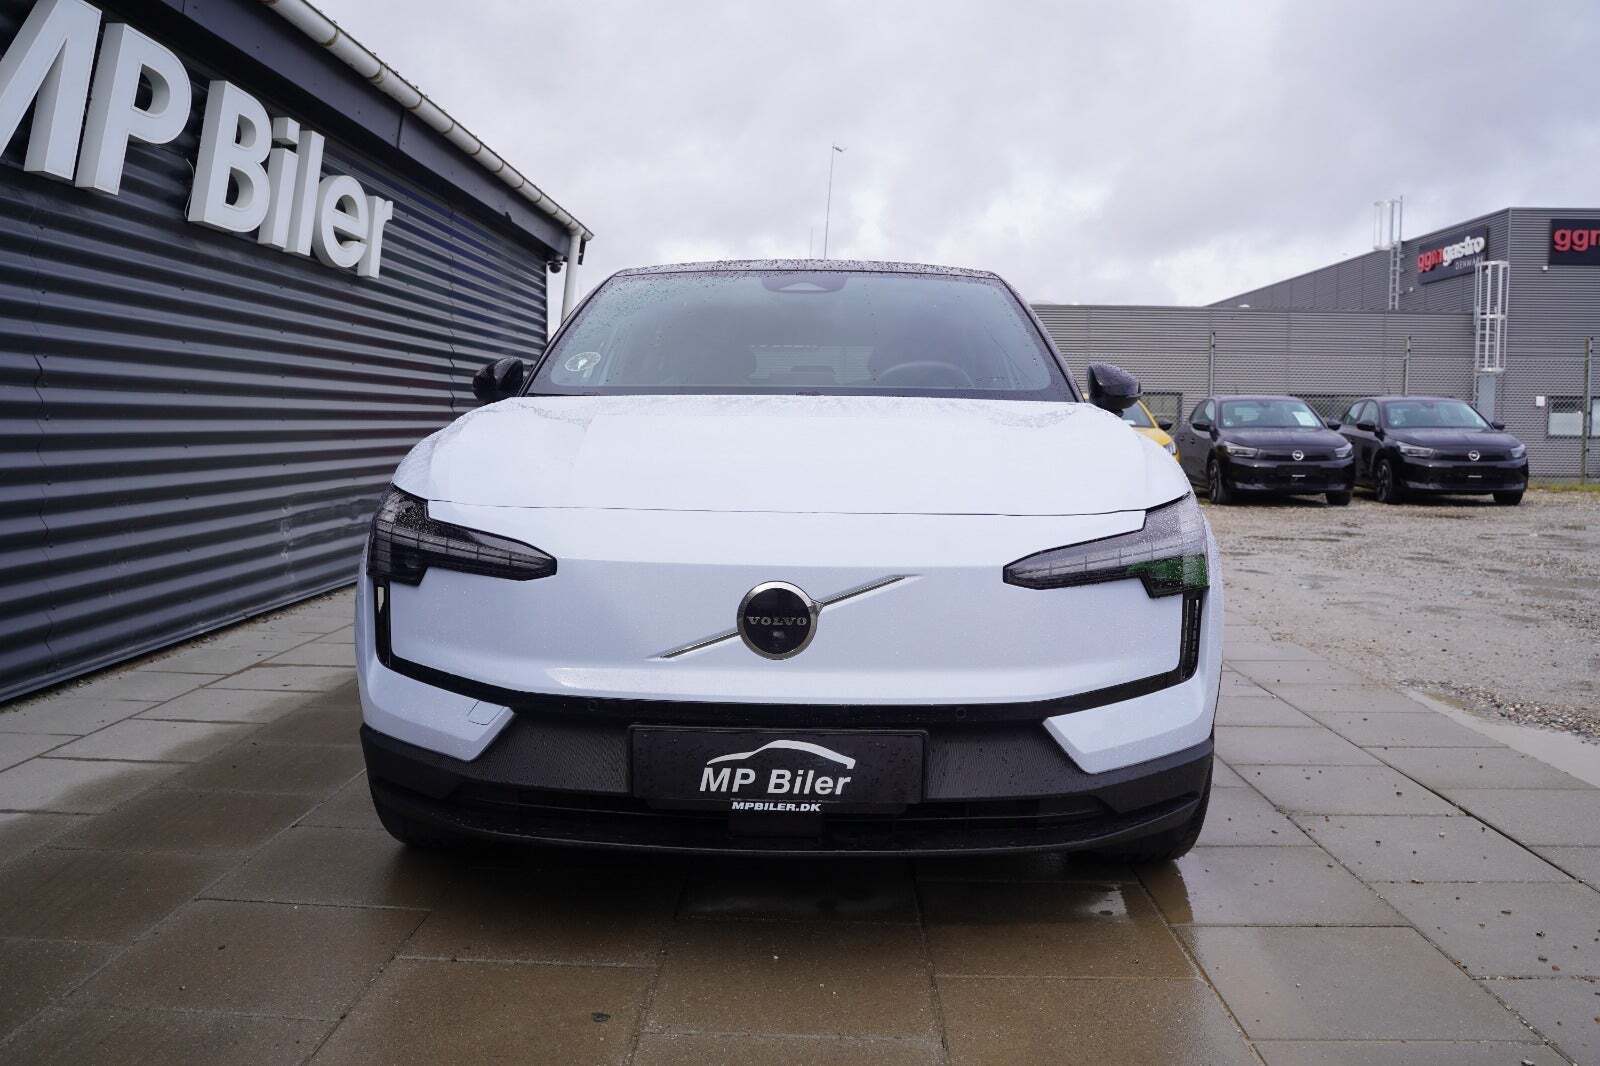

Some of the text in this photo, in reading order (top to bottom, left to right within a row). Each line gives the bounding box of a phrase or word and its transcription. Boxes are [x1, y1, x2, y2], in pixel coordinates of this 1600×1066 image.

[188, 80, 393, 279] Biler
[747, 616, 807, 626] VOLVO
[699, 767, 852, 795] MP Biler
[731, 801, 822, 812] MPBILER.DK
